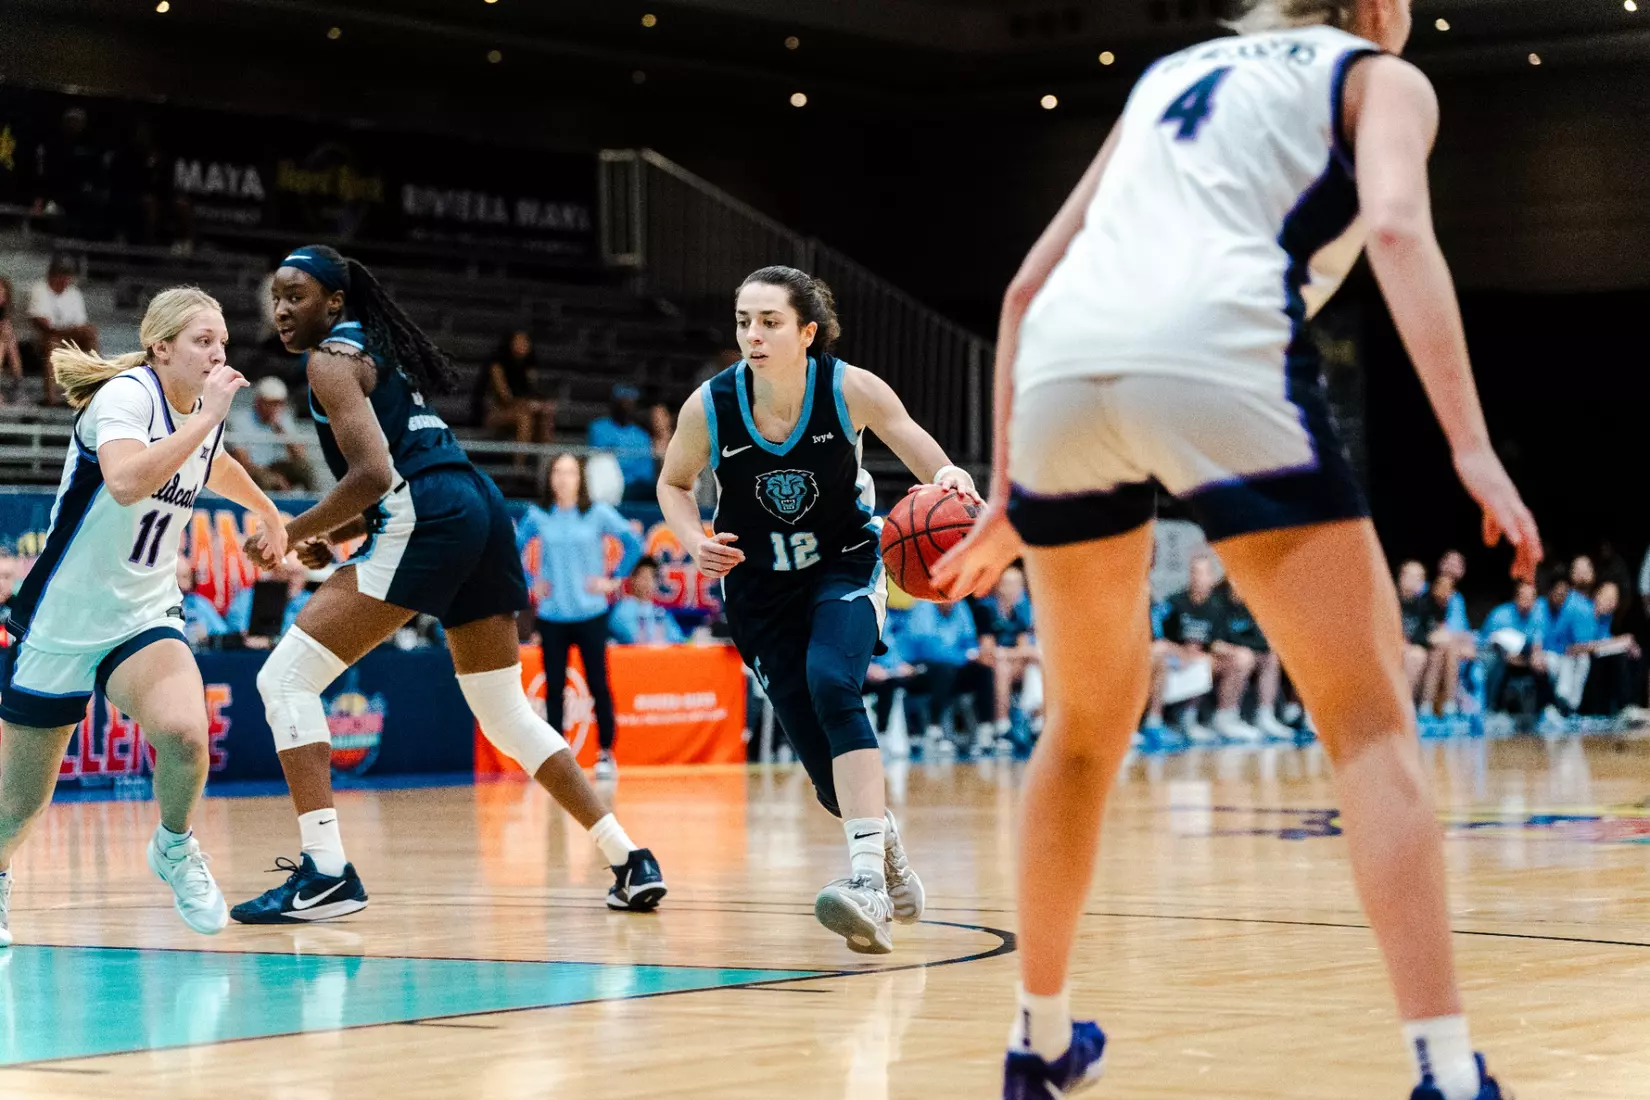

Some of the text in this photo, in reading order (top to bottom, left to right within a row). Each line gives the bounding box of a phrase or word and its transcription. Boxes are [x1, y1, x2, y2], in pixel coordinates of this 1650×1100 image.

[1156, 64, 1235, 141] 4
[174, 158, 265, 200] MAYA
[128, 508, 174, 568] 11
[769, 530, 822, 572] 12
